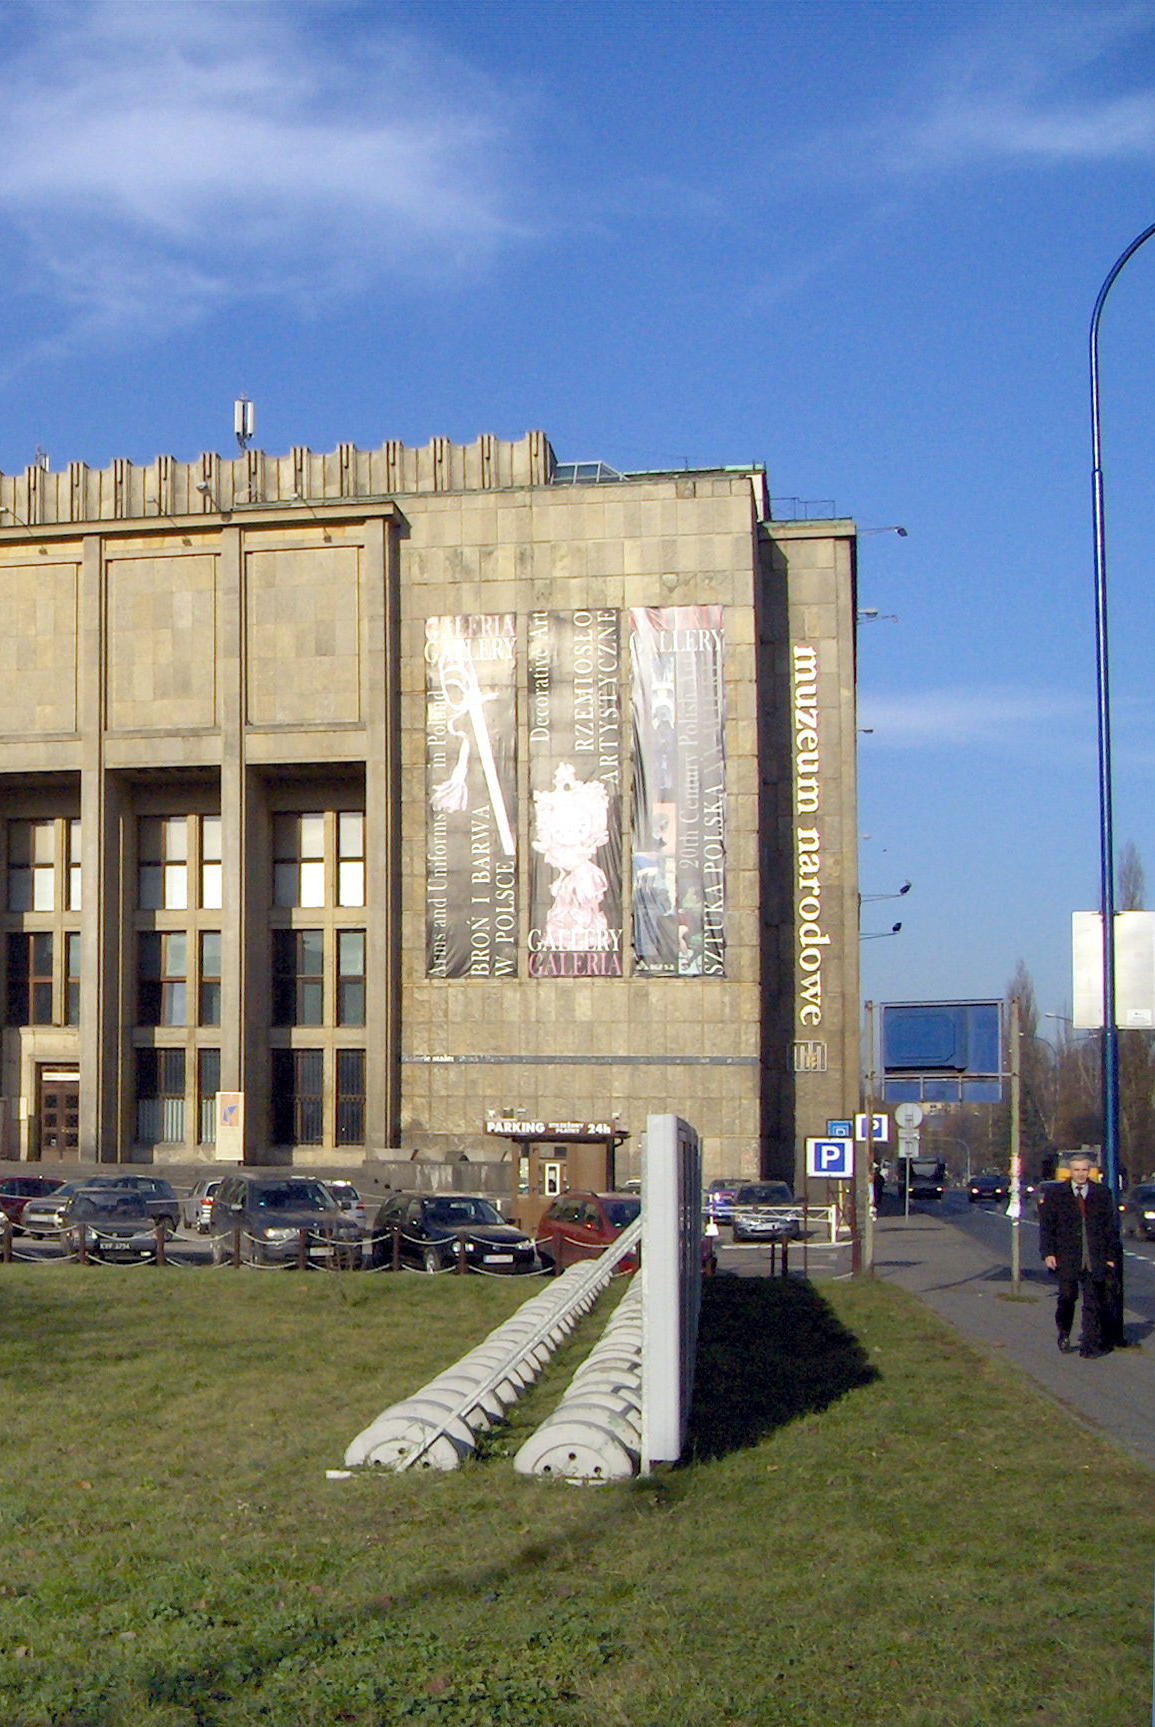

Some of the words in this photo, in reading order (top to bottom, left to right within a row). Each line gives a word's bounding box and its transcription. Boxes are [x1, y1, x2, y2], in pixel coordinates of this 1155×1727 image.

[424, 637, 517, 663] GALLERY
[425, 615, 516, 640] GALERIA
[529, 611, 549, 640] Art
[529, 650, 550, 742] Decorative
[573, 611, 595, 752] RZEMIOSŁO
[597, 609, 619, 785] ARTYSTYCZNE
[427, 690, 446, 746] Poland
[678, 693, 698, 746] Polish
[794, 644, 820, 816] muzeum
[428, 749, 446, 767] in
[427, 813, 447, 892] Uniforms
[471, 804, 491, 884] BARWA
[679, 831, 699, 869] 20th
[703, 784, 724, 873] POLSKA
[428, 897, 447, 928] and
[495, 861, 515, 943] POLSCE
[797, 825, 831, 1027] narodowe
[466, 916, 491, 976] BROŃ
[527, 929, 623, 952] GALLERY
[704, 884, 724, 975] SZTUKA
[428, 933, 447, 978] Arms
[495, 955, 515, 977] W
[529, 952, 622, 977] GALERIA
[486, 1121, 546, 1133] PARKING
[587, 1123, 612, 1134] 24h
[821, 1145, 841, 1170] P
